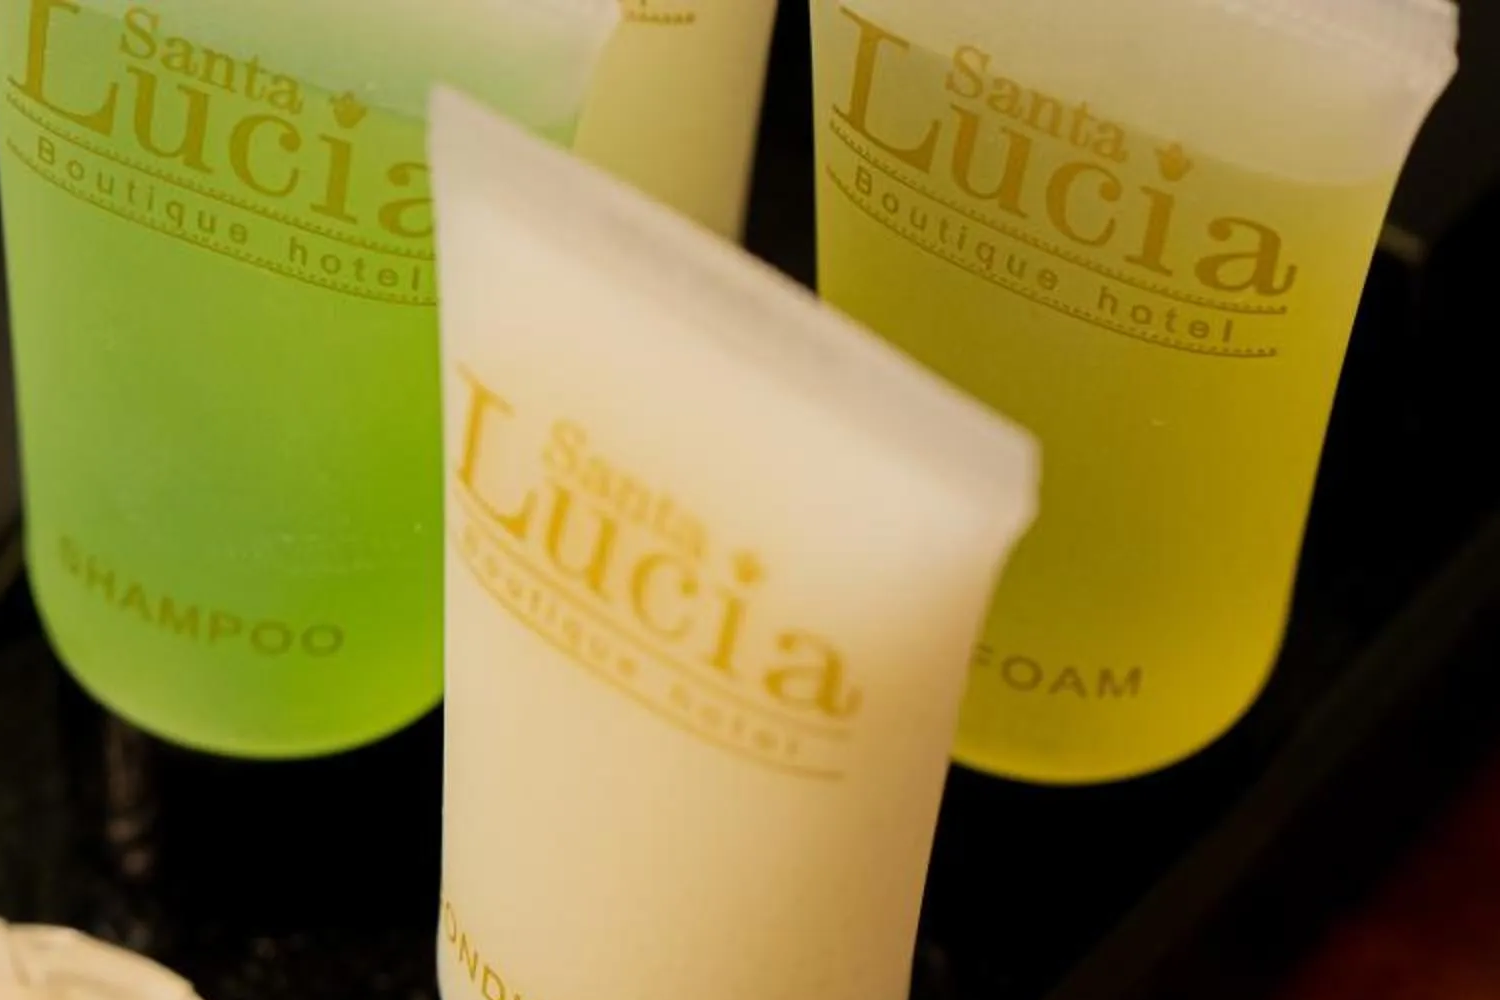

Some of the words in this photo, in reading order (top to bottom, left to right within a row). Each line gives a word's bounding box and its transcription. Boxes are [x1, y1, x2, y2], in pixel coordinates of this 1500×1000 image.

[118, 8, 301, 114] Santa
[945, 45, 1127, 163] Santa
[37, 136, 248, 245] Boutique
[288, 236, 422, 291] hotel
[832, 4, 1298, 297] Lucia
[854, 165, 1059, 292] Boutique
[1097, 285, 1234, 345] hotel
[58, 535, 344, 658] SHAMPOO
[457, 360, 863, 720] Lucia
